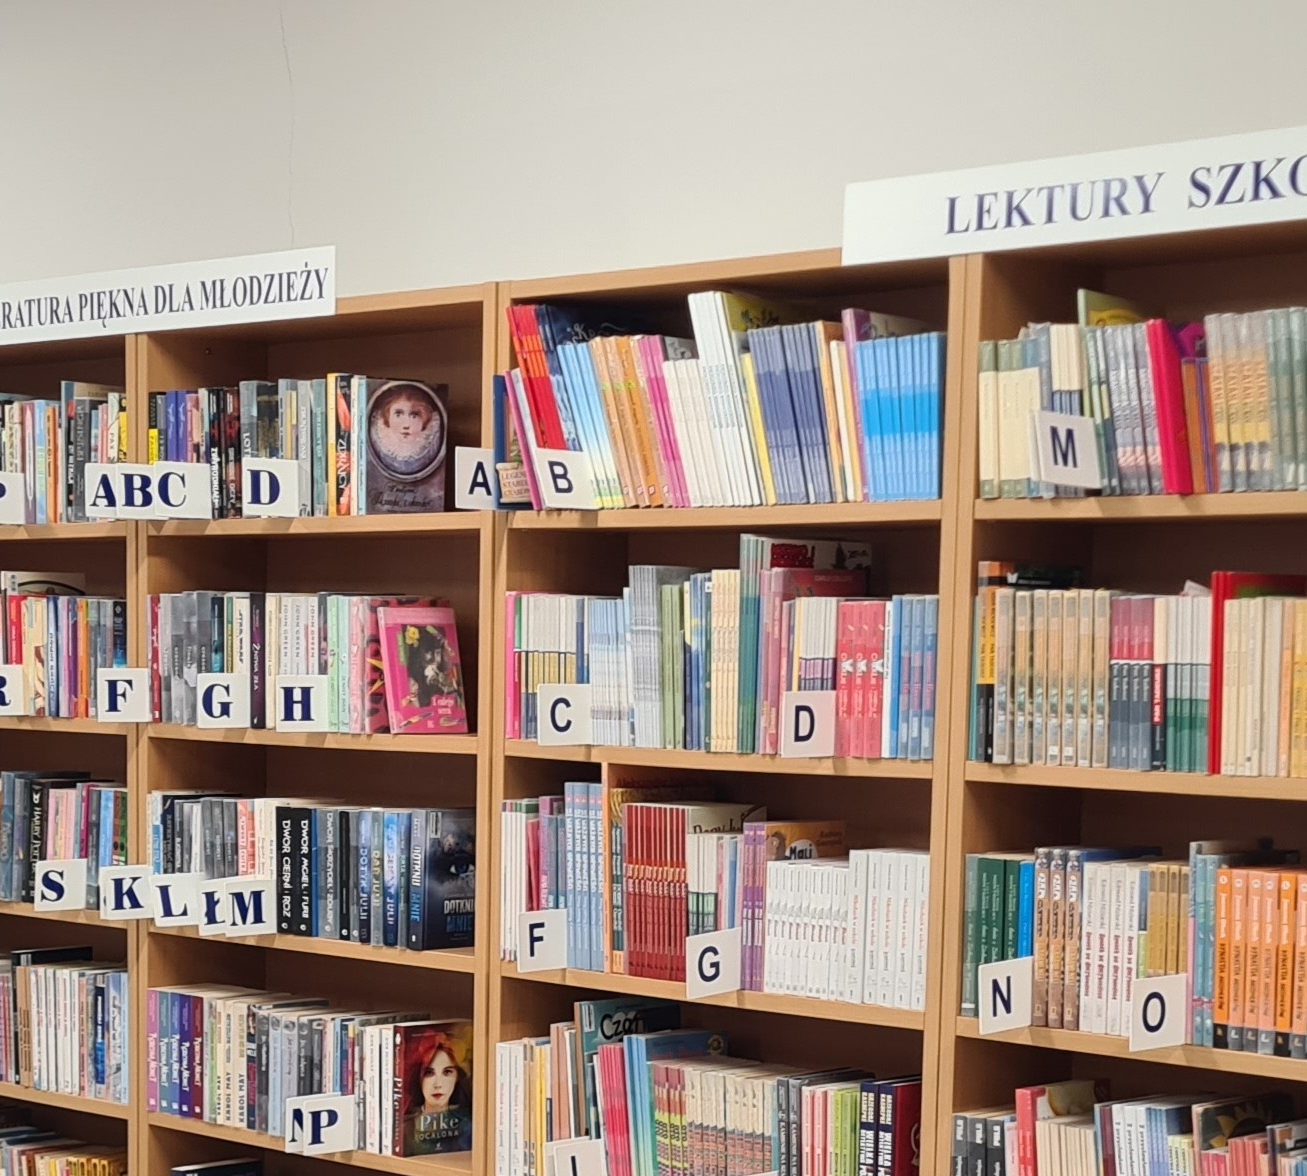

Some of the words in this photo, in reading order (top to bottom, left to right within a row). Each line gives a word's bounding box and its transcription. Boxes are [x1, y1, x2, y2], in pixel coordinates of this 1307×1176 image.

[943, 171, 1168, 237] LEKTURY
[76, 284, 149, 326] PIĘKNA
[153, 279, 194, 313] DLA
[199, 261, 329, 311] MŁODZIEŻY
[1049, 425, 1078, 469] M
[89, 473, 117, 508] A
[121, 473, 153, 508] B
[157, 471, 187, 508] C
[247, 468, 281, 506] D
[468, 461, 493, 497] A
[547, 460, 574, 494] B
[104, 679, 134, 713] F
[201, 683, 233, 719] G
[280, 686, 315, 722] H
[550, 697, 572, 733] C
[793, 704, 815, 743] D
[33, 807, 42, 839] HARRY
[40, 869, 65, 903] S
[111, 876, 144, 911] K
[156, 884, 189, 919] L
[228, 889, 266, 927] M
[444, 899, 475, 915] DOTKNI
[528, 921, 545, 958] F
[697, 945, 720, 983] G
[991, 975, 1012, 1018] N
[1141, 991, 1166, 1033] O
[308, 1109, 339, 1146] P
[420, 1113, 460, 1131] Pike
